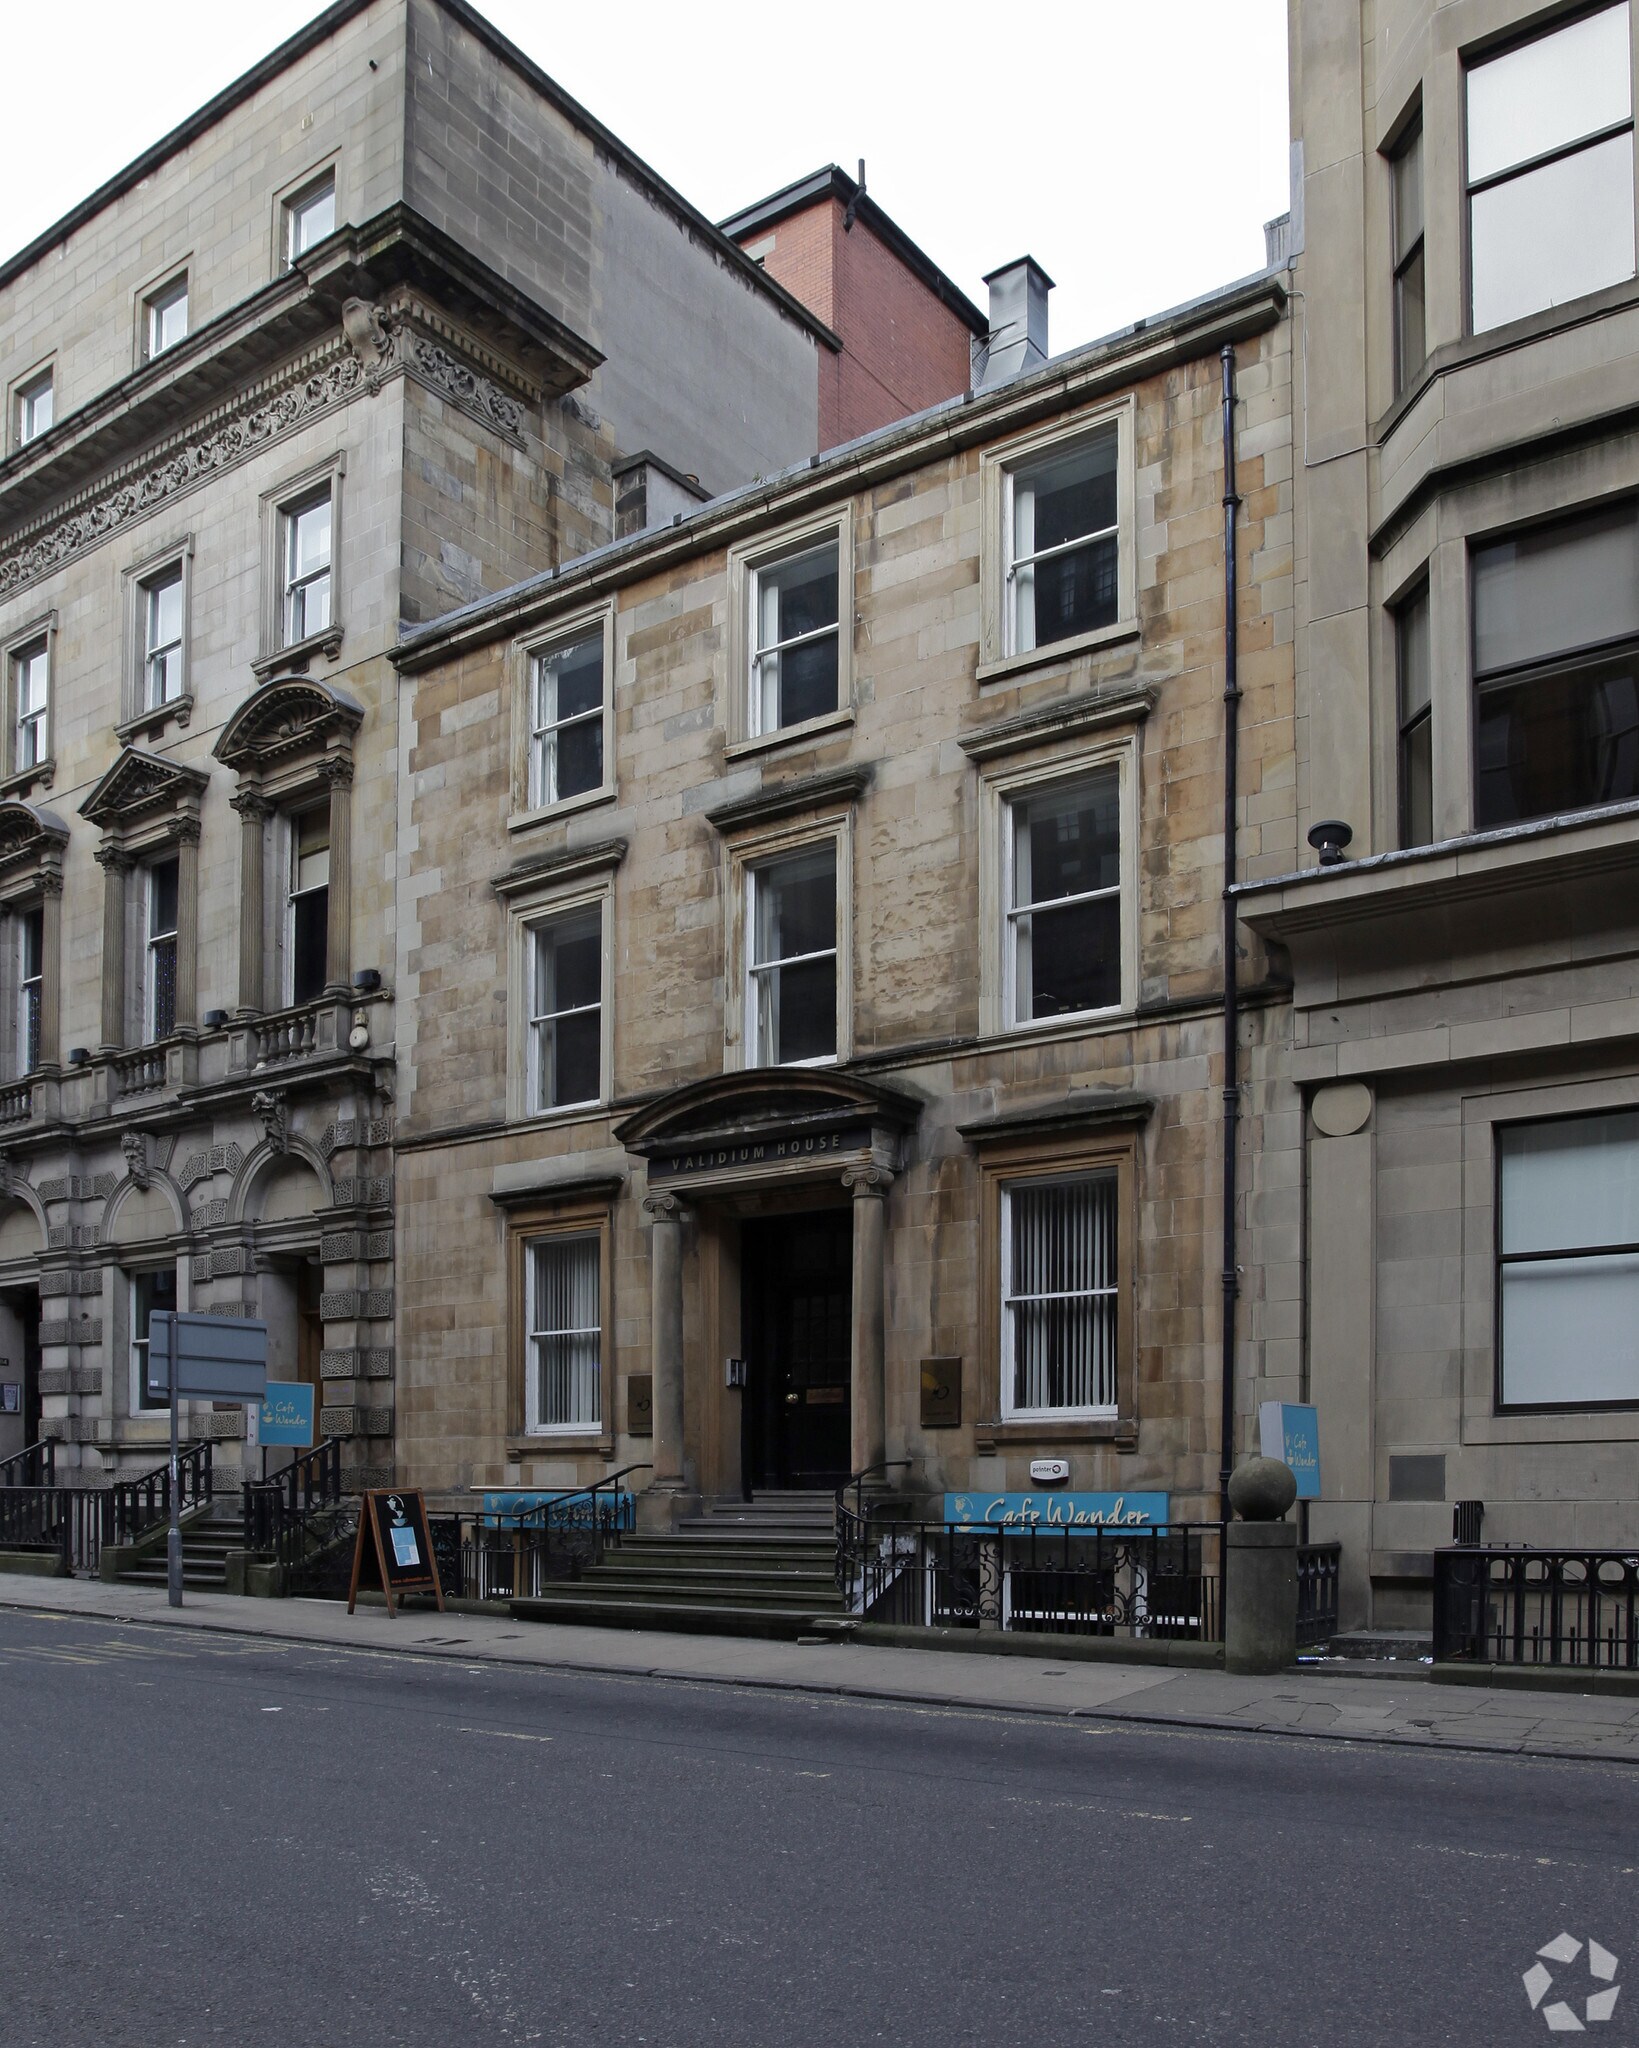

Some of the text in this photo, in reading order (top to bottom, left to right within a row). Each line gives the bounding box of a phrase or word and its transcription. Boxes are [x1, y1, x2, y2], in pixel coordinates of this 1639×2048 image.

[672, 1134, 840, 1170] VALIDIUM HOUSE
[985, 1496, 1150, 1532] Cafe Wander
